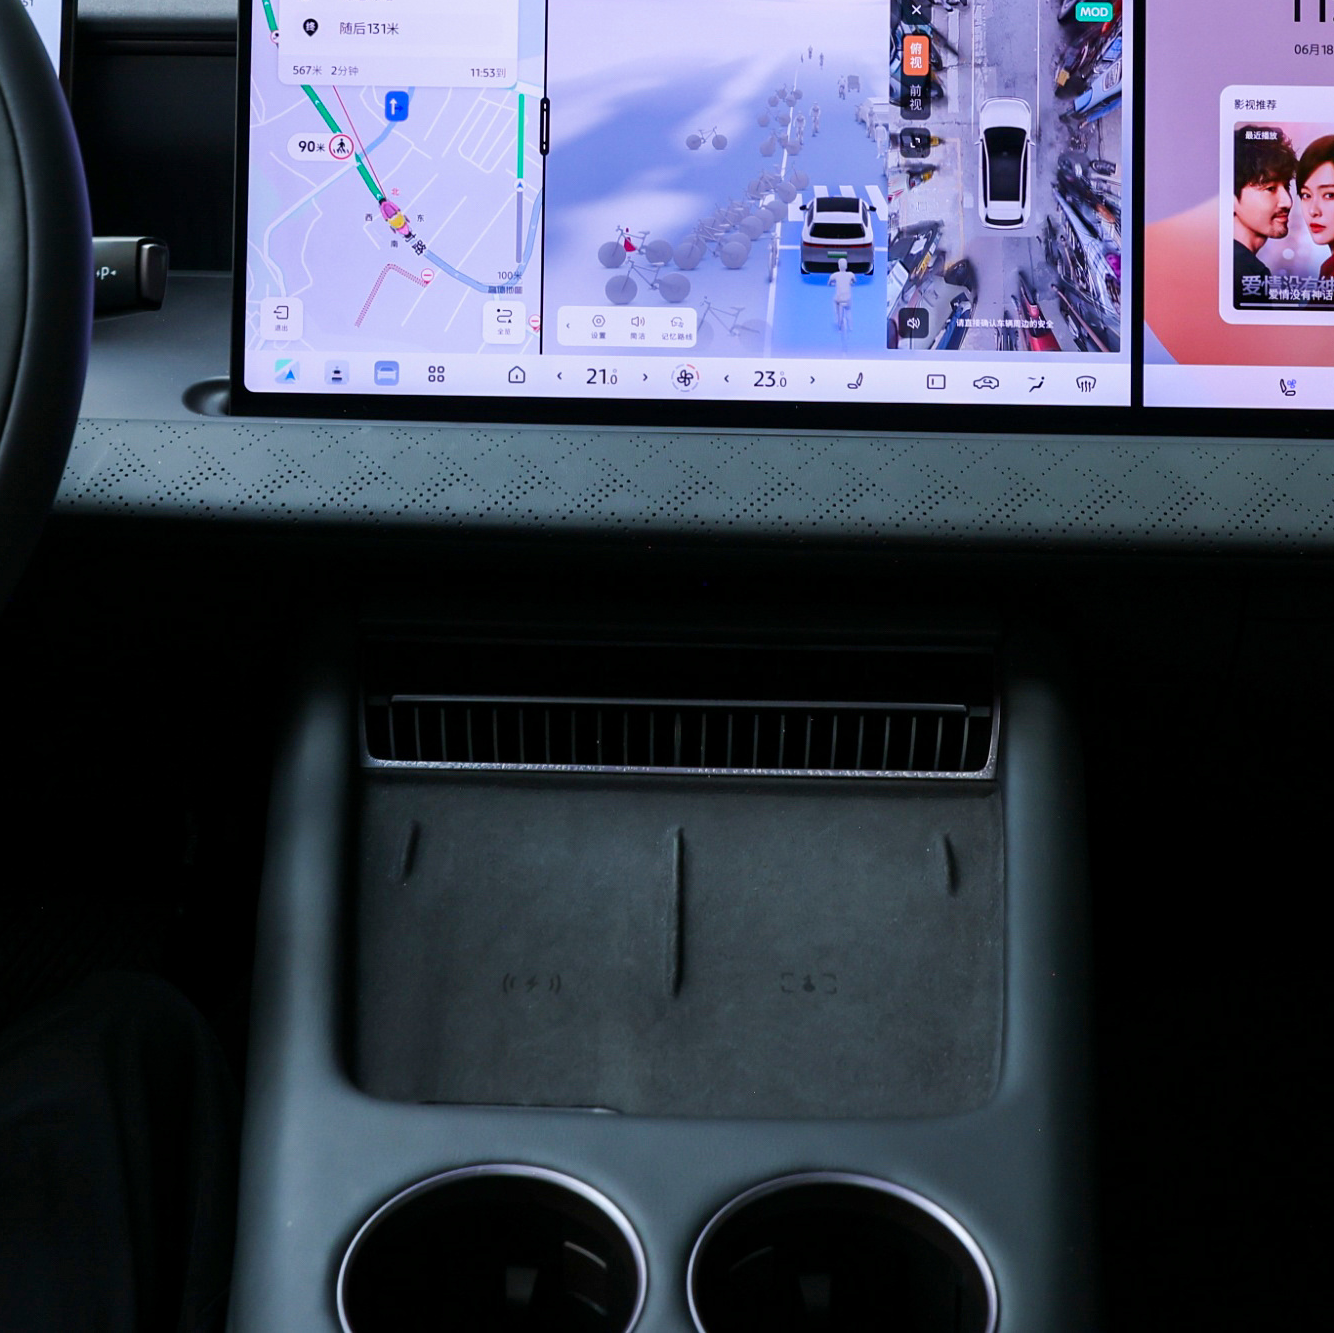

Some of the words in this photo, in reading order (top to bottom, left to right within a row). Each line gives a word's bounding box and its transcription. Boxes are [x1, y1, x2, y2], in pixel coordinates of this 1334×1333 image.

[1079, 7, 1109, 17] MOD
[339, 22, 399, 36] 随后131米
[292, 65, 323, 76] 567米
[331, 65, 359, 77] 2分钟
[470, 68, 506, 78] 11:53到
[909, 84, 922, 111] 前视
[1234, 99, 1277, 111] 影视推荐
[1245, 130, 1278, 141] 最近播放
[298, 140, 325, 153] 90米
[497, 271, 523, 281] 100米
[1268, 289, 1334, 301] 爱情没有神话
[956, 318, 1055, 329] 请直接确认车辆周边的安全
[591, 332, 606, 340] 设置
[661, 333, 693, 341] 记忆路线
